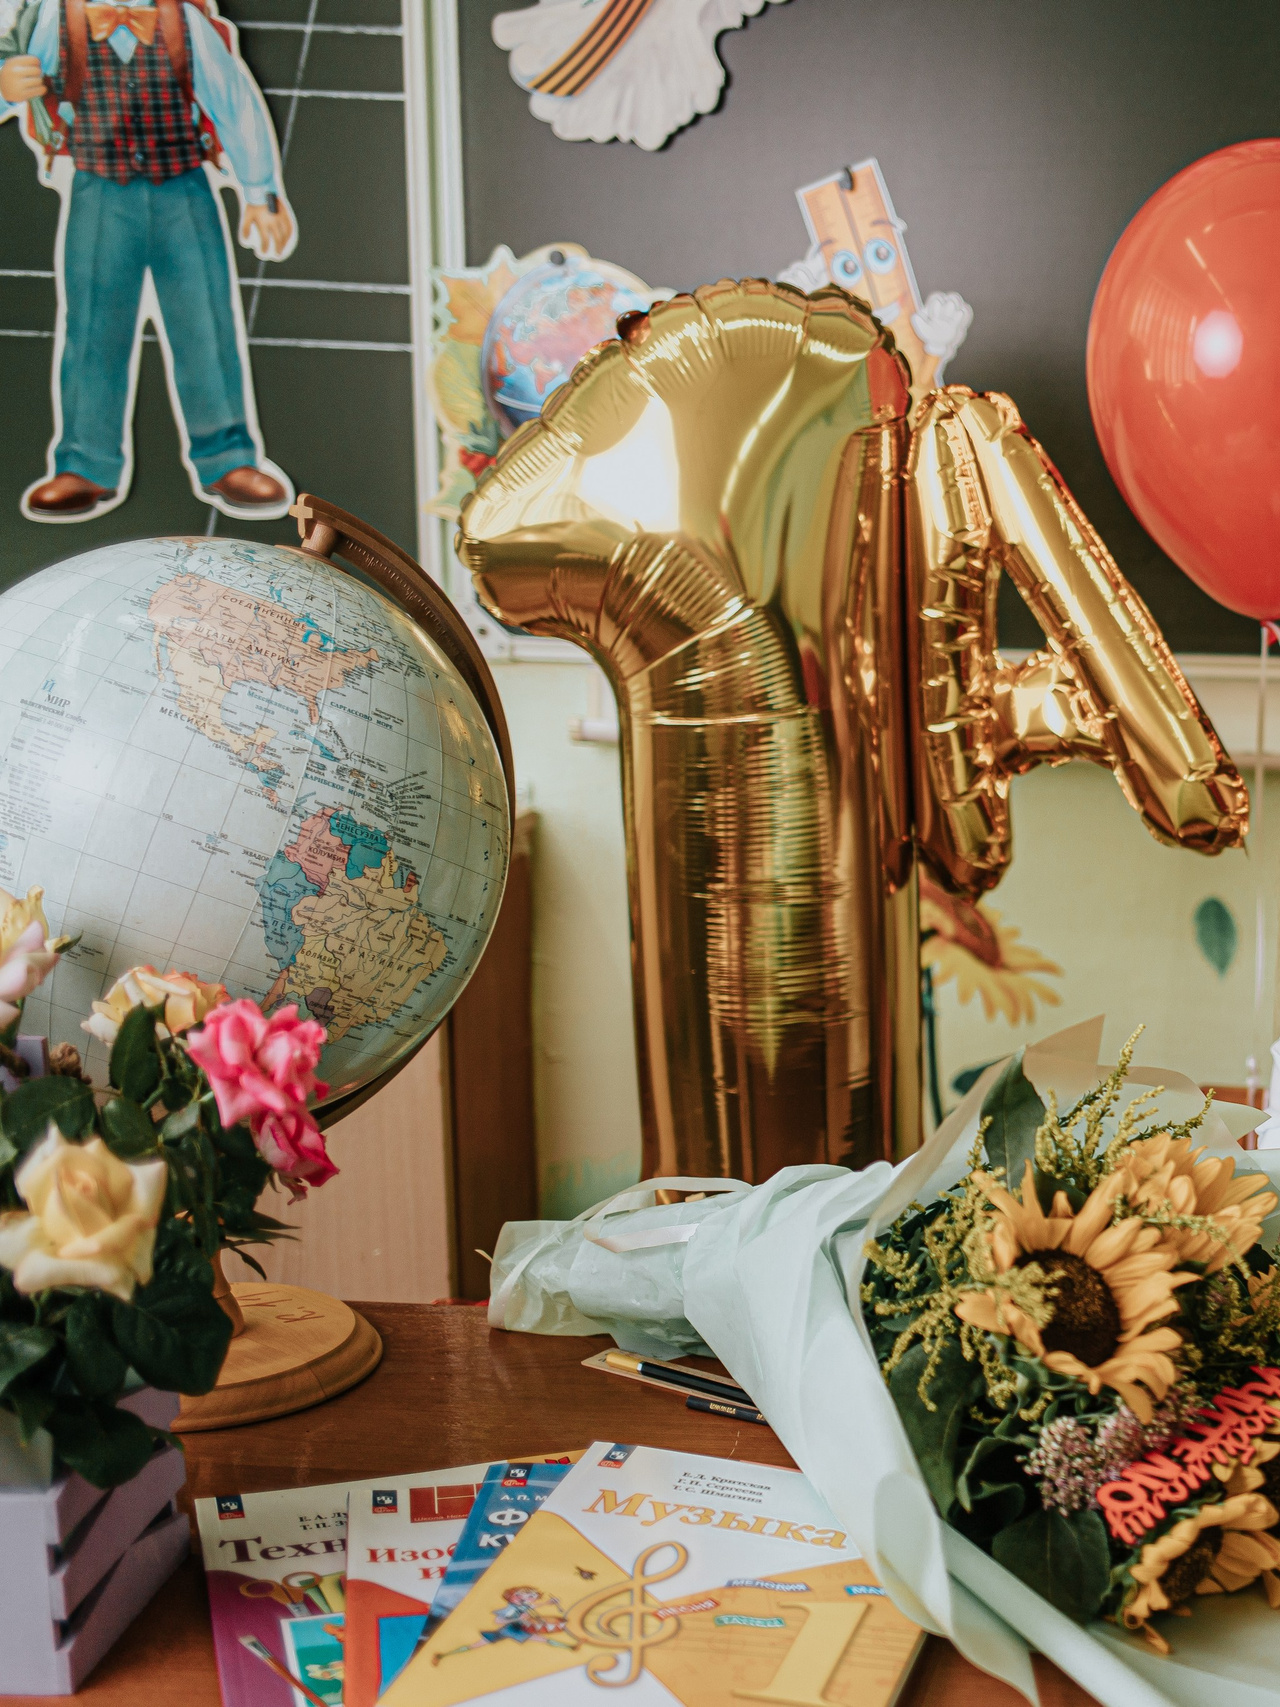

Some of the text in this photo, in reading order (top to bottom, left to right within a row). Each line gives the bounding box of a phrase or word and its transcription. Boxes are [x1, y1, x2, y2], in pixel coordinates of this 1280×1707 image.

[222, 594, 307, 631] СОЕДИНЕННЫЕ
[194, 626, 301, 668] ШТАТЫ АМЕРИКИ
[159, 706, 207, 729] МЕКСИКА
[336, 821, 379, 842] ВЕНЕСУЭЛА
[271, 920, 301, 934] ПЕРУ
[706, 1482, 763, 1496] Сергеева
[710, 1476, 772, 1491] Критская
[582, 1488, 848, 1550] Музыка
